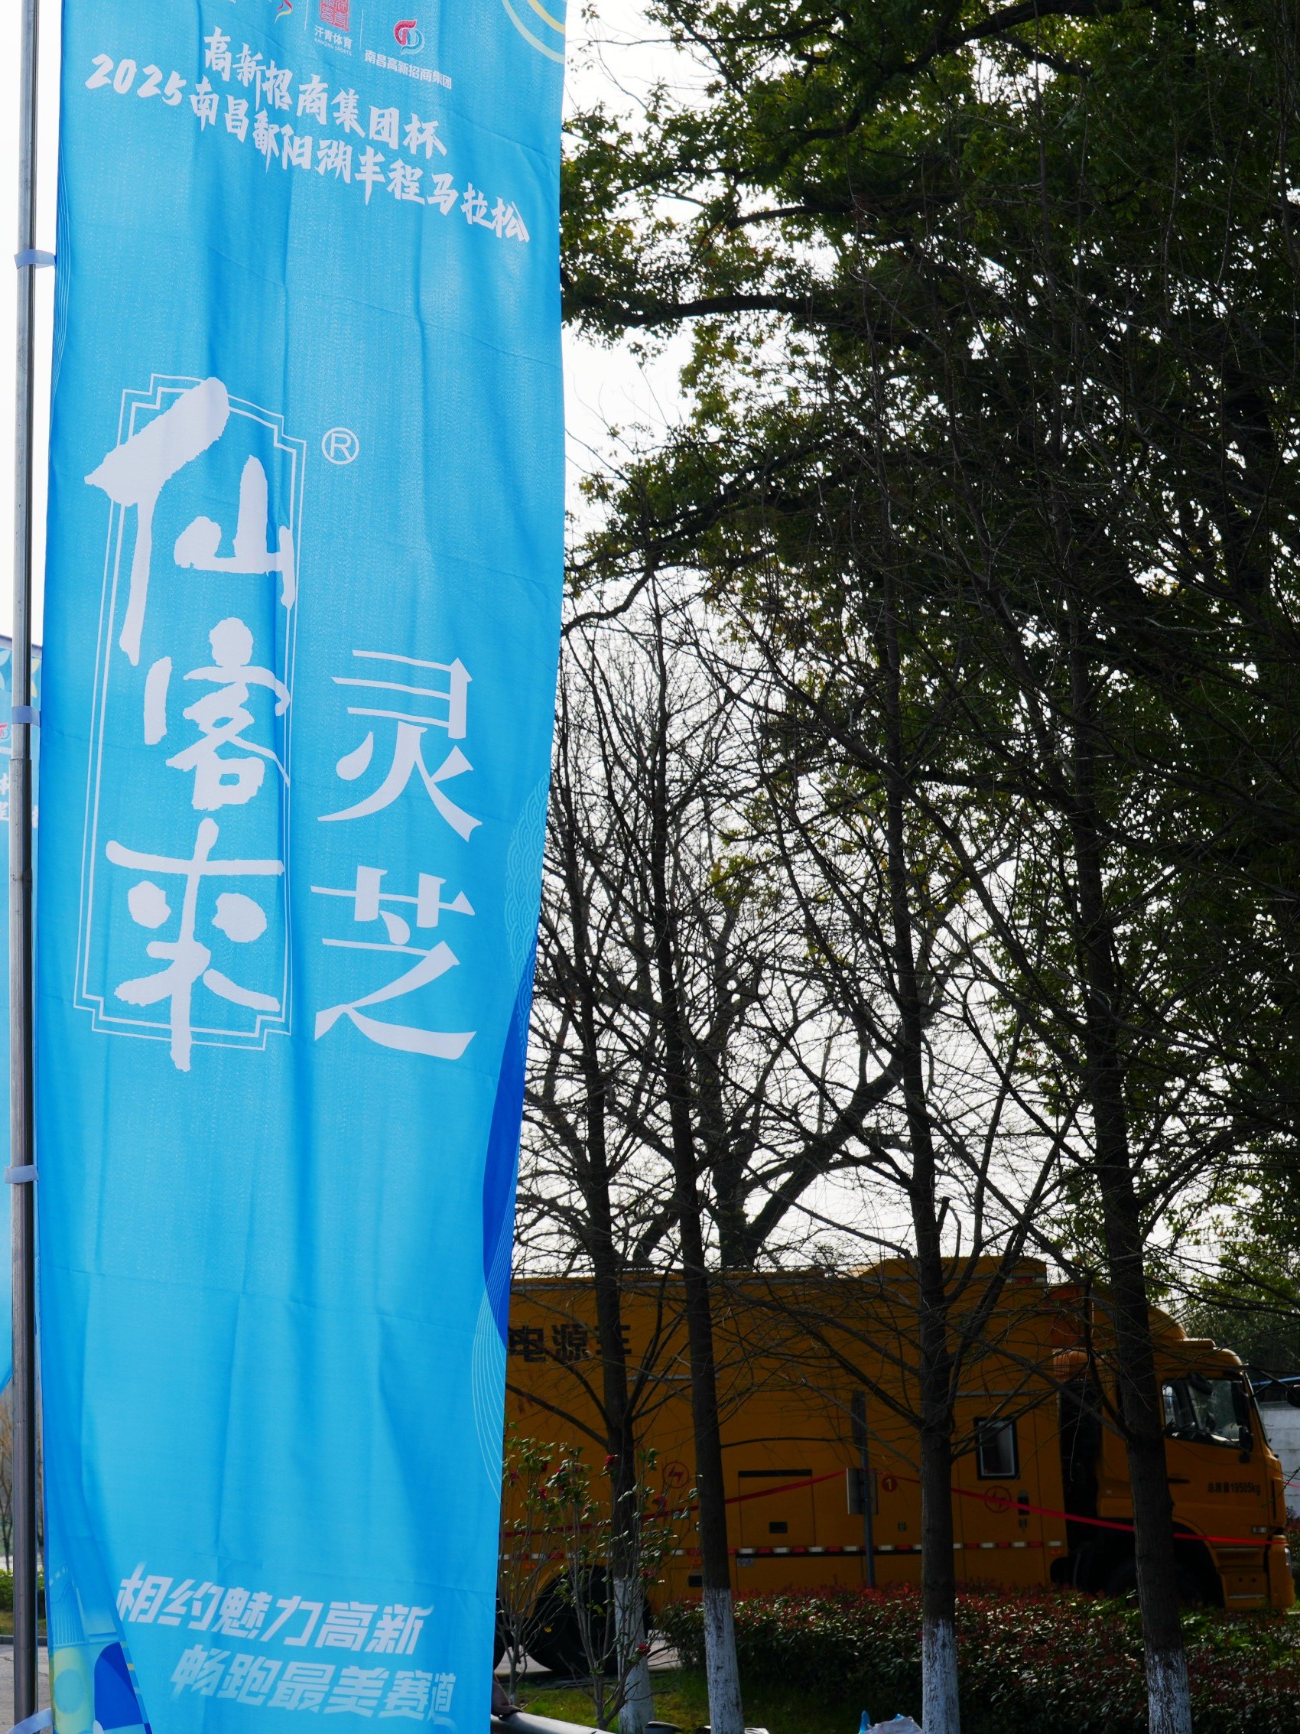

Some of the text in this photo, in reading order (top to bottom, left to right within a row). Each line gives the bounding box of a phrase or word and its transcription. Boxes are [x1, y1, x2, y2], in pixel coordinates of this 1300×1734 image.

[203, 26, 447, 159] 高新招商集团杯
[314, 25, 353, 49] 汗青体育
[365, 50, 452, 90] 南昌高新招商集团
[85, 53, 530, 243] 2025南昌鄱阳湖半程马拉松
[84, 376, 296, 1072] 仙客来
[311, 649, 482, 1060] 灵芝
[116, 1561, 434, 1655] 相约魅力高新
[170, 1644, 457, 1732] 畅跑最美赛道
